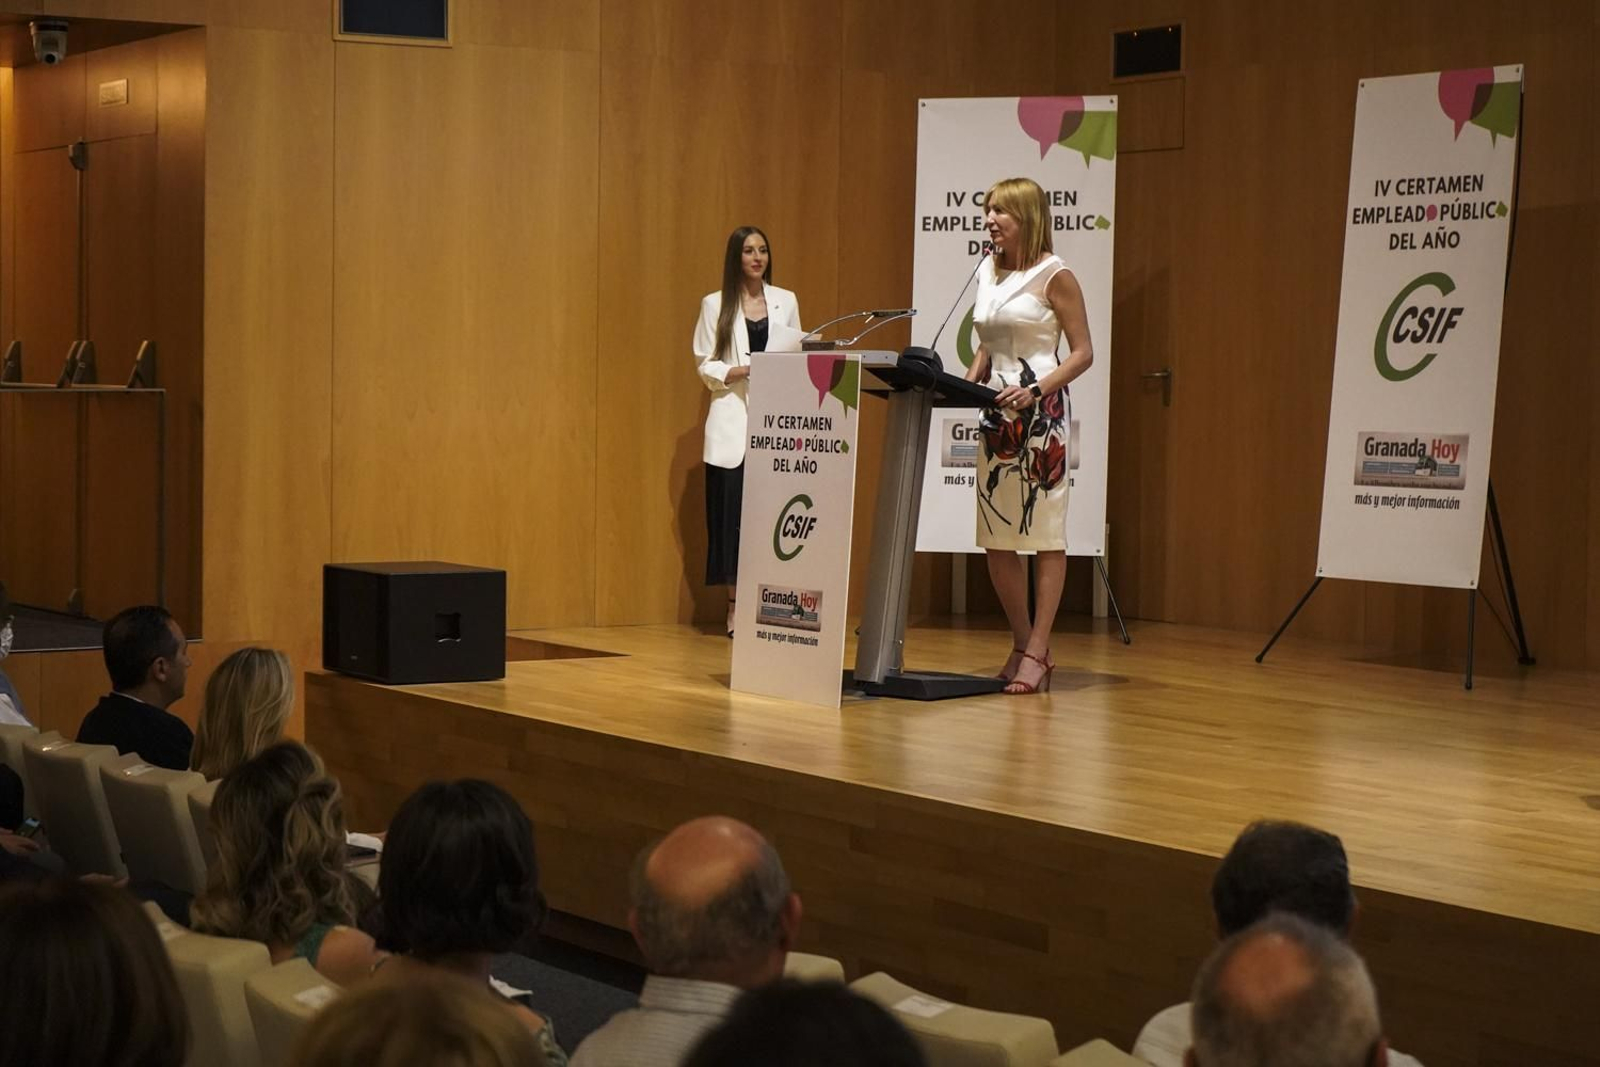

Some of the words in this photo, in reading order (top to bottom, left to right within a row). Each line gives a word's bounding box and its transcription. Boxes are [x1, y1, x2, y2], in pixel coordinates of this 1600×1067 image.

[1374, 180, 1392, 197] IV
[1395, 174, 1484, 196] CERTAMEN
[946, 191, 966, 207] IV
[1389, 233, 1417, 250] DEL
[1422, 226, 1460, 250] AÑO
[1392, 306, 1465, 344] CSIF
[764, 415, 775, 428] IV
[777, 415, 832, 431] CERTAMEN
[1364, 436, 1427, 458] Granada
[1431, 439, 1461, 464] Hoy
[773, 458, 790, 472] DEL
[794, 456, 817, 474] AÑO
[944, 473, 966, 486] más
[968, 475, 975, 488] y
[1354, 492, 1372, 505] más
[1374, 495, 1380, 508] y
[1381, 493, 1406, 509] mejor
[1407, 495, 1460, 510] información
[782, 514, 817, 539] CSIF
[762, 588, 798, 606] Granada
[800, 592, 818, 612] Hoy
